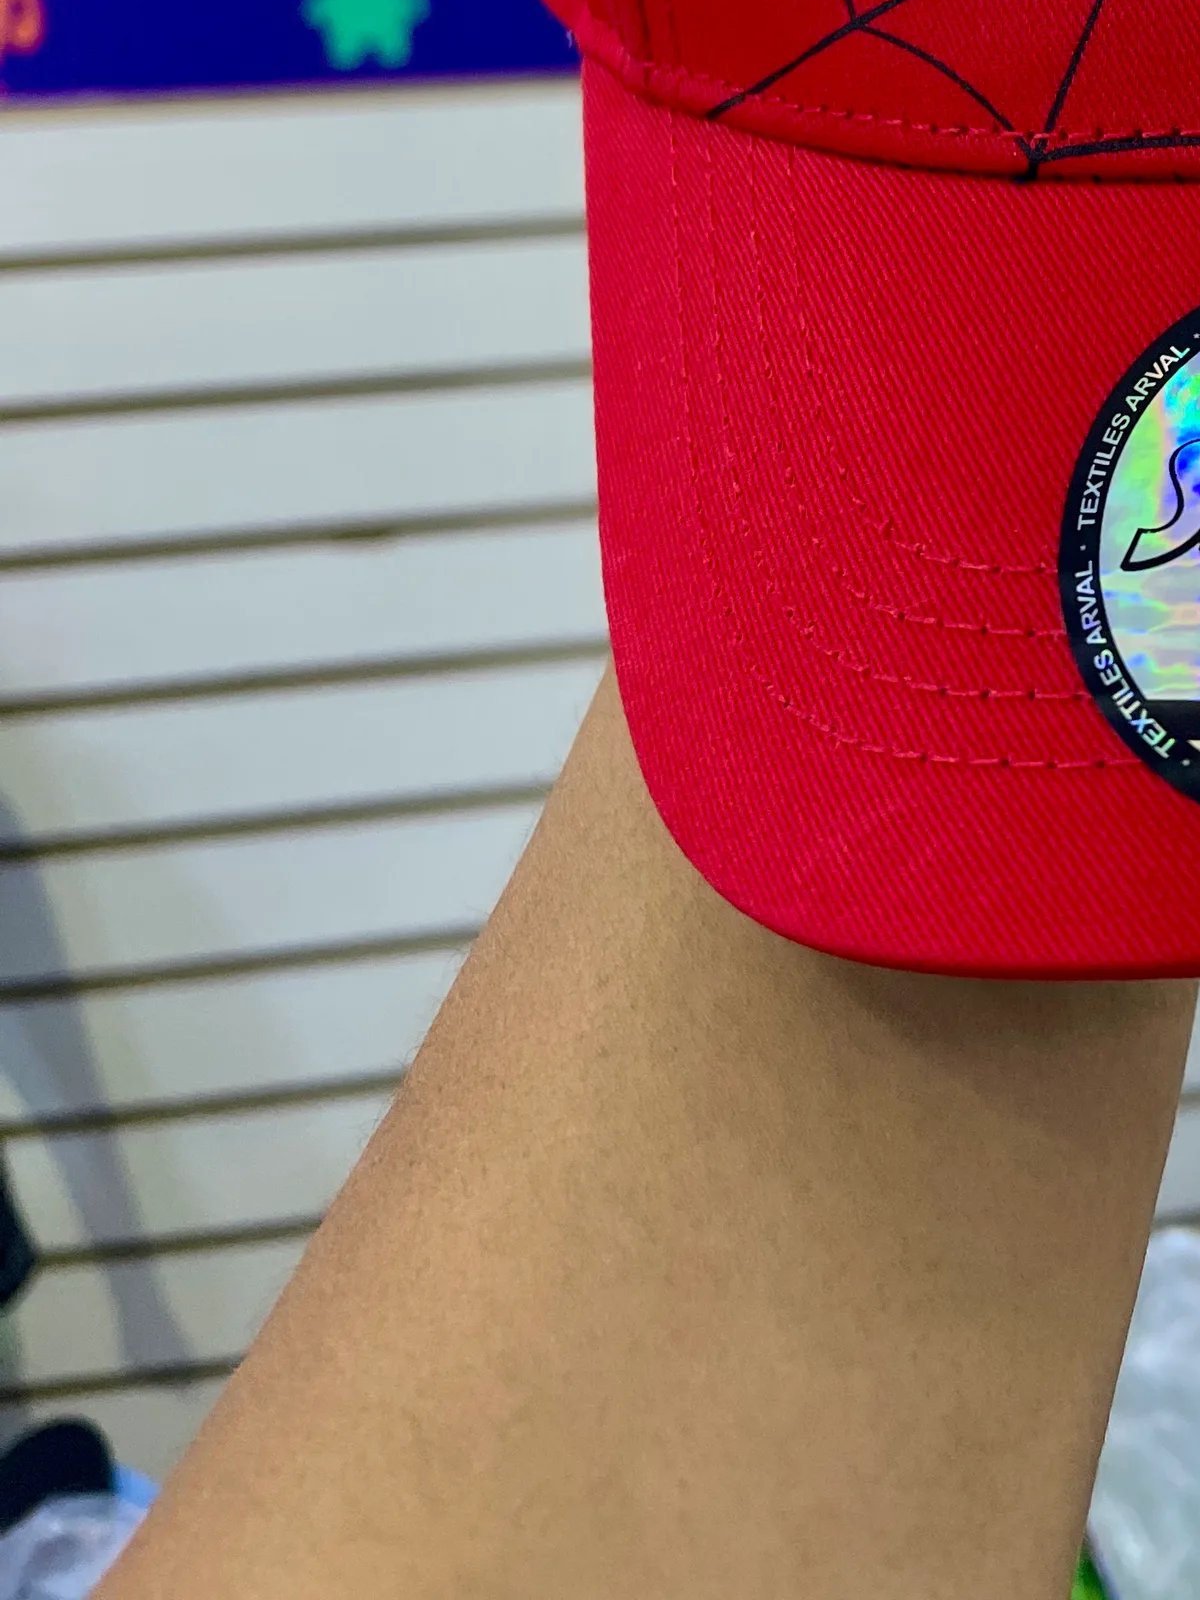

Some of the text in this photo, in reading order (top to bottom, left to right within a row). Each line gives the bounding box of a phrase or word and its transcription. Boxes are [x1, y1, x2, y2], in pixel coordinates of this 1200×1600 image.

[1077, 345, 1190, 530] TEXTILES ARVAL
[1075, 560, 1176, 759] TEXTILES ARVAL
